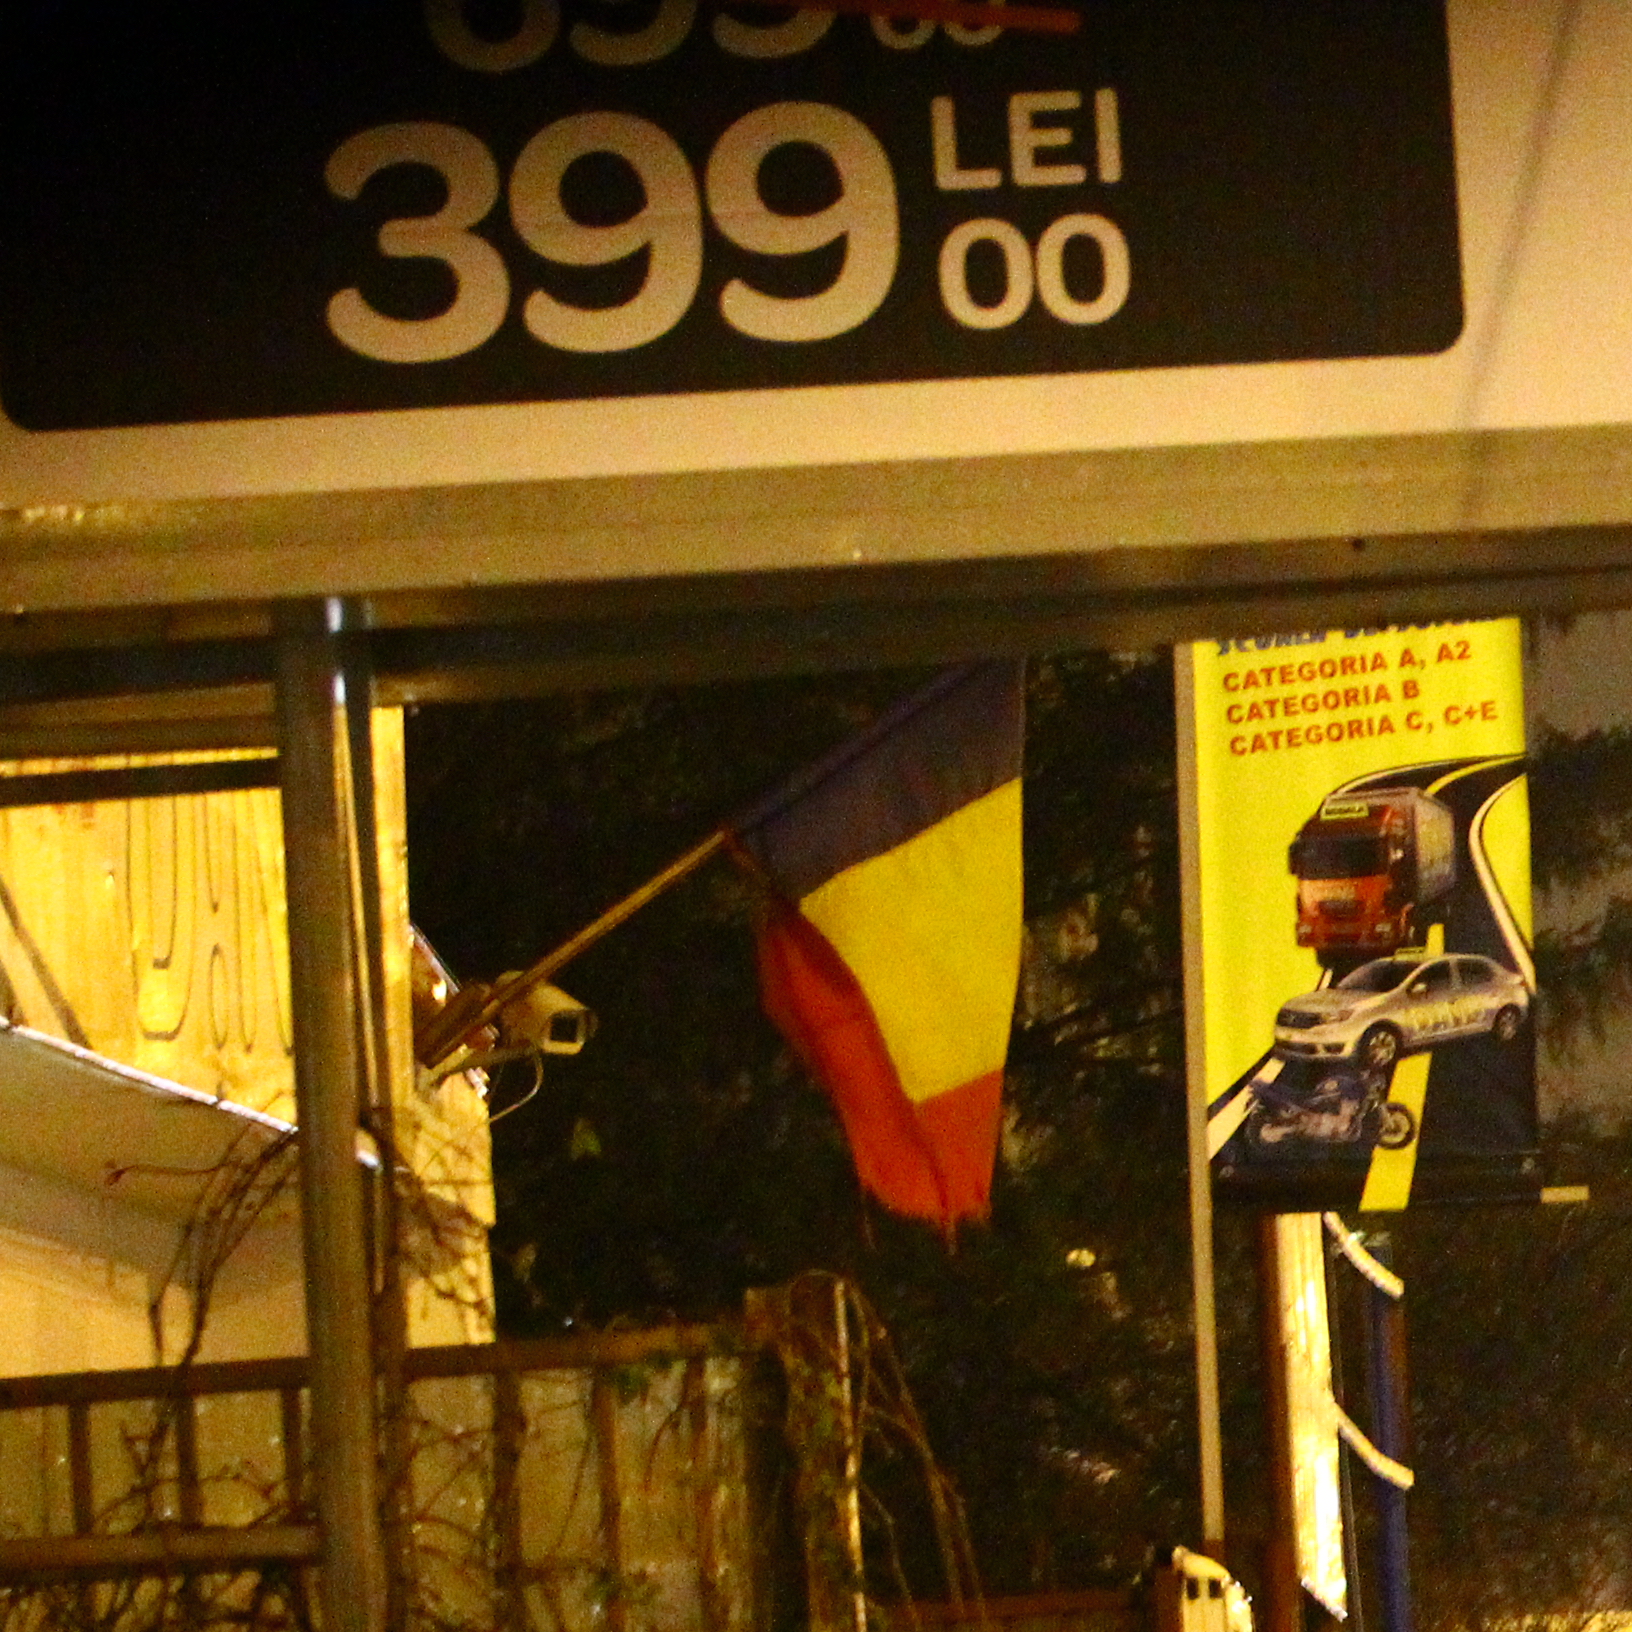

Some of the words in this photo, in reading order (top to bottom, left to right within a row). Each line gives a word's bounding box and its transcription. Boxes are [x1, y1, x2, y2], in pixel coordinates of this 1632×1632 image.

[931, 88, 1123, 192] LEI
[323, 100, 900, 364] 399
[938, 213, 1131, 330] 00
[1223, 652, 1388, 692] CATEGORIA
[1399, 648, 1427, 670] A,
[1437, 640, 1473, 663] A2
[1226, 684, 1392, 725] CATEGORIA
[1402, 679, 1420, 700] B
[1230, 714, 1396, 756] CATEGORIA
[1405, 711, 1434, 734] C,
[1444, 700, 1498, 725] C+E
